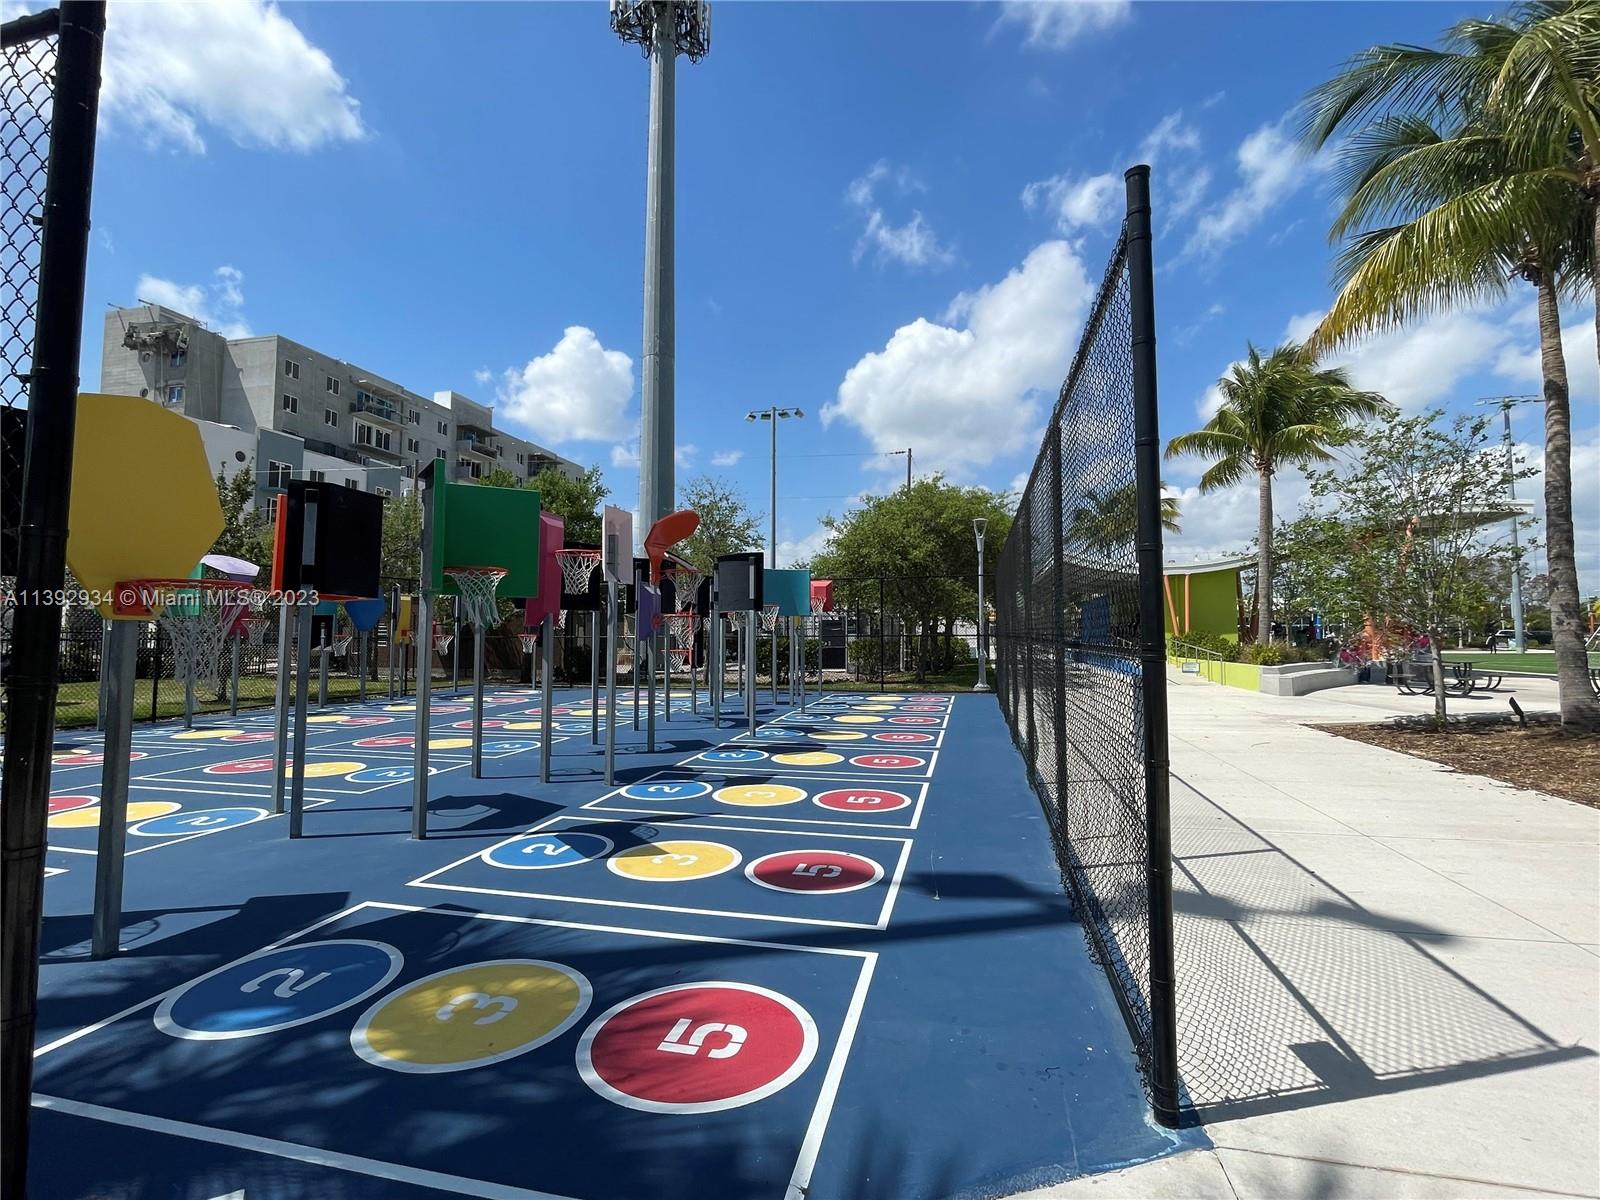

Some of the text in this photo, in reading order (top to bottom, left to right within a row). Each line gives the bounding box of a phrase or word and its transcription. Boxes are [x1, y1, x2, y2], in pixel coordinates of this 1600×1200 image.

[376, 770, 411, 778] 2
[647, 784, 682, 793] 2
[846, 796, 882, 804] 5
[176, 816, 226, 826] 2
[522, 841, 843, 878] 2 3 5
[239, 966, 748, 1060] 2 3 5
